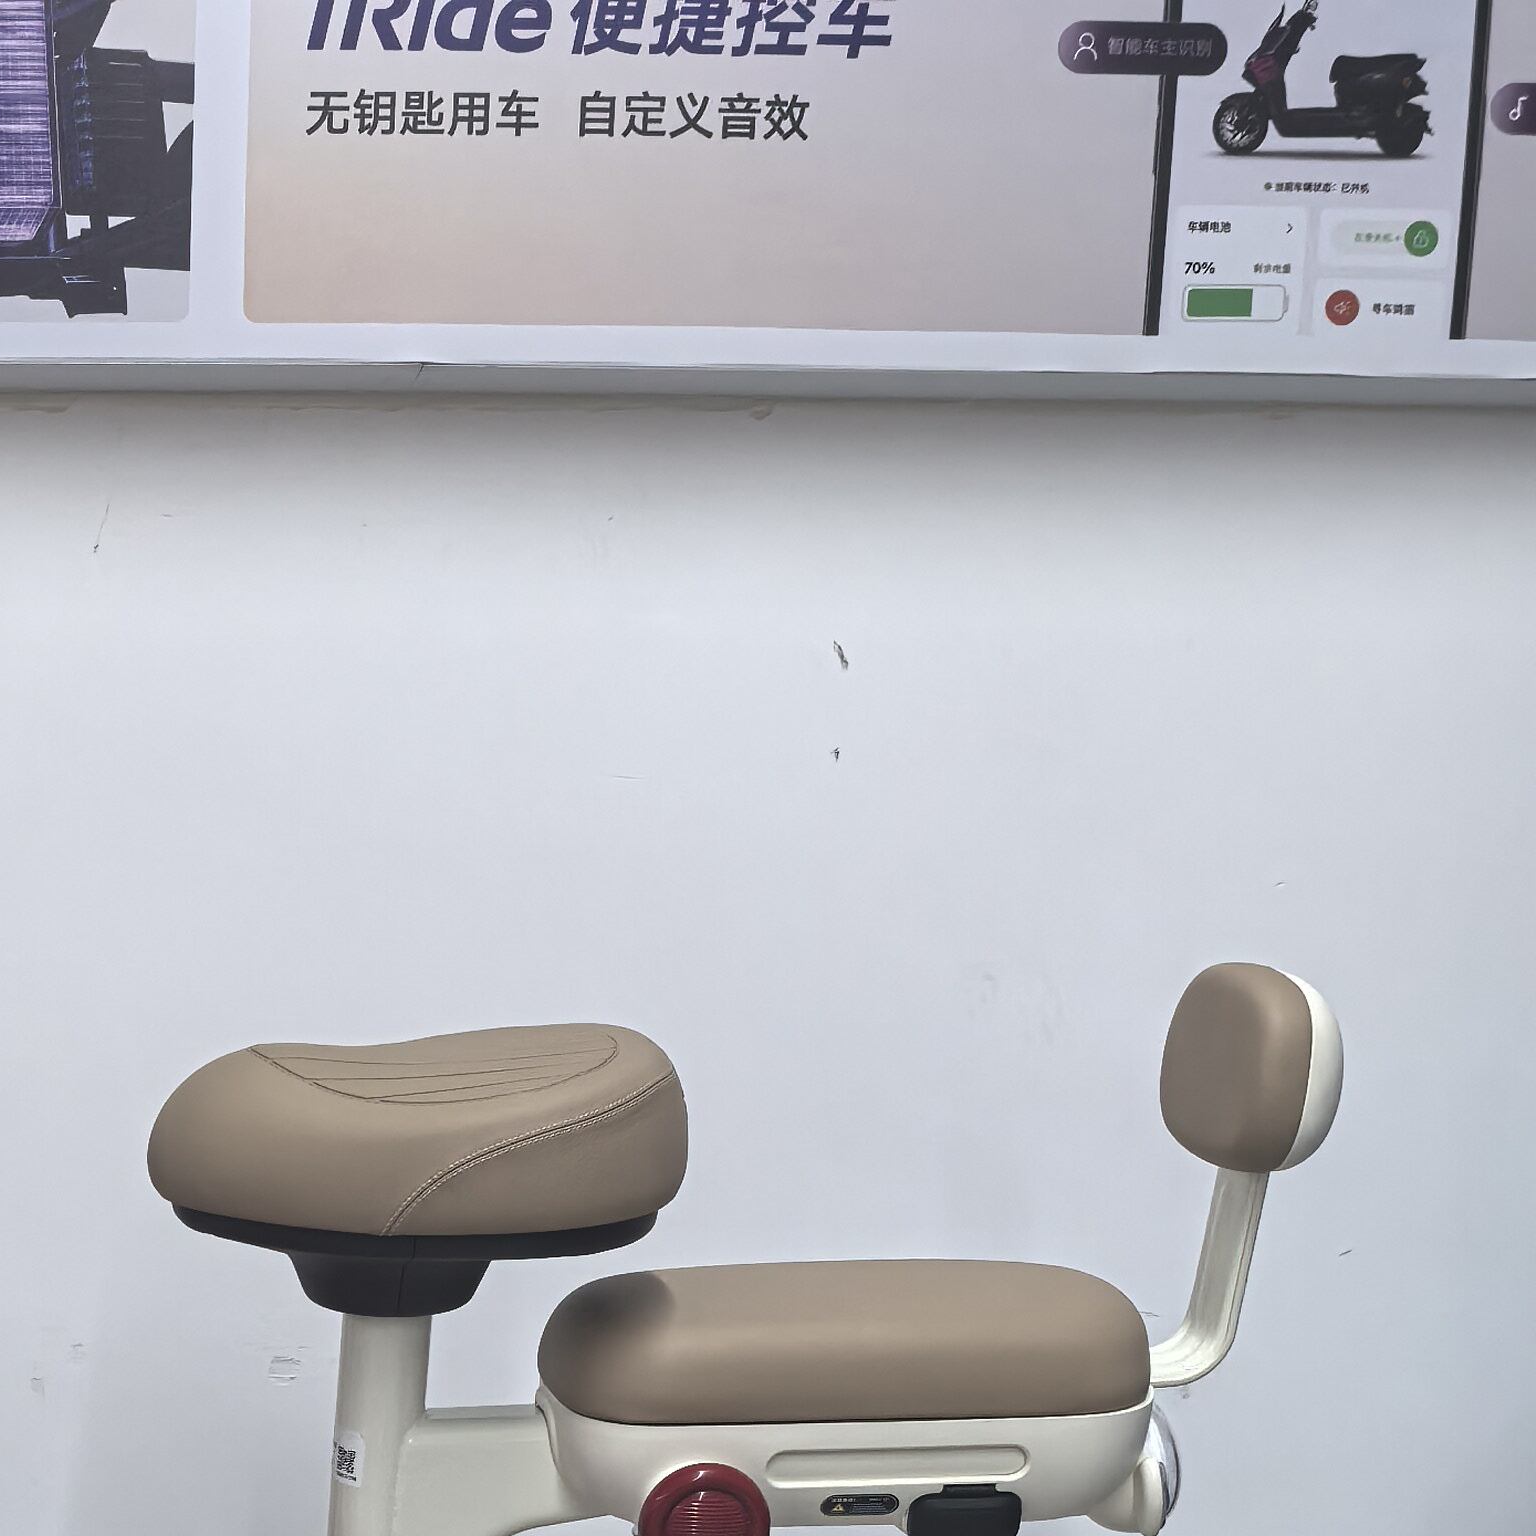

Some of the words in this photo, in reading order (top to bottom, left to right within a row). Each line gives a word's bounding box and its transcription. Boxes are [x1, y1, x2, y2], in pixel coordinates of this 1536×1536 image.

[569, 0, 892, 58] 便捷控车
[305, 89, 540, 137] 无钥匙用车
[578, 92, 810, 141] 自定义音效
[1184, 261, 1216, 275] 70%
